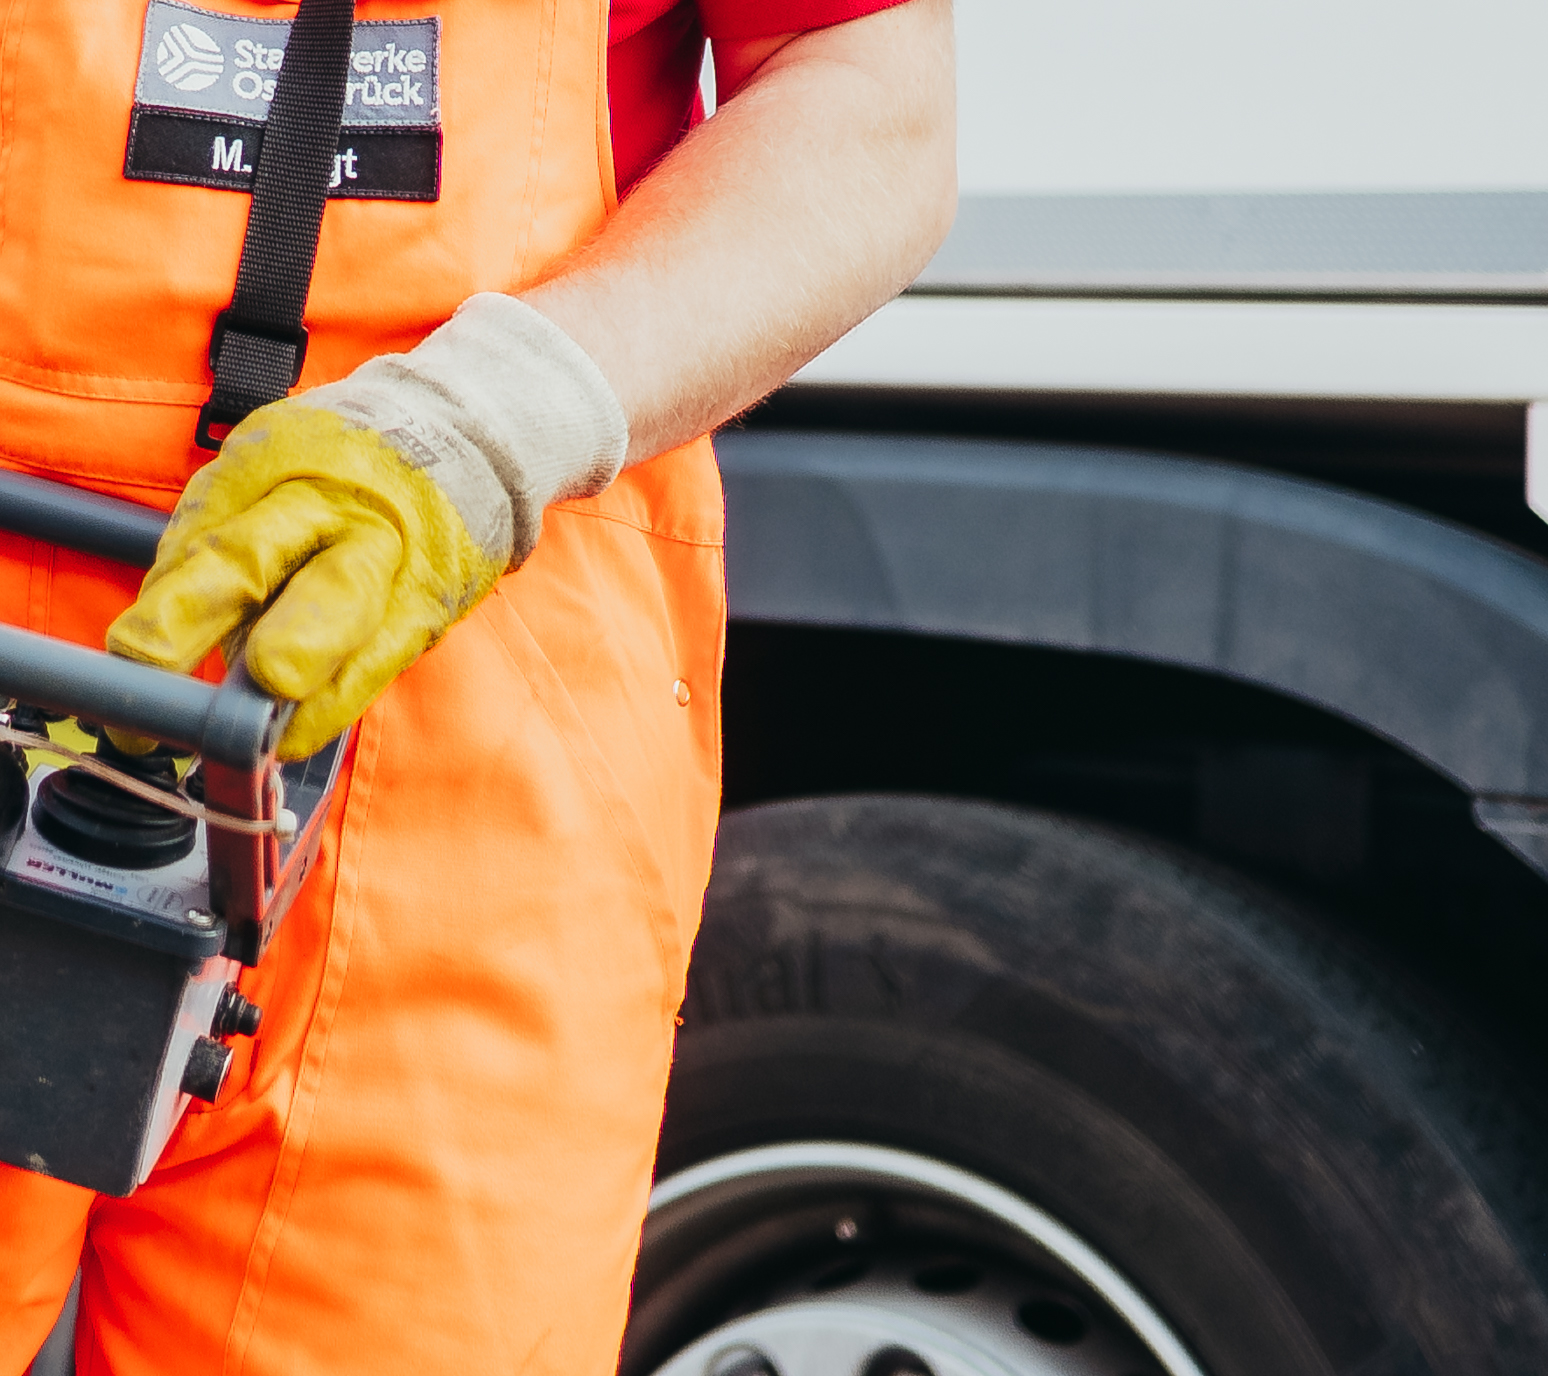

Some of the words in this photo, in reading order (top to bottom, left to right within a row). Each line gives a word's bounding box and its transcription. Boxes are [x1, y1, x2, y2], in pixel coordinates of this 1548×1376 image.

[233, 38, 427, 74] Staerke
[232, 70, 425, 107] Osrück
[210, 135, 253, 173] M.
